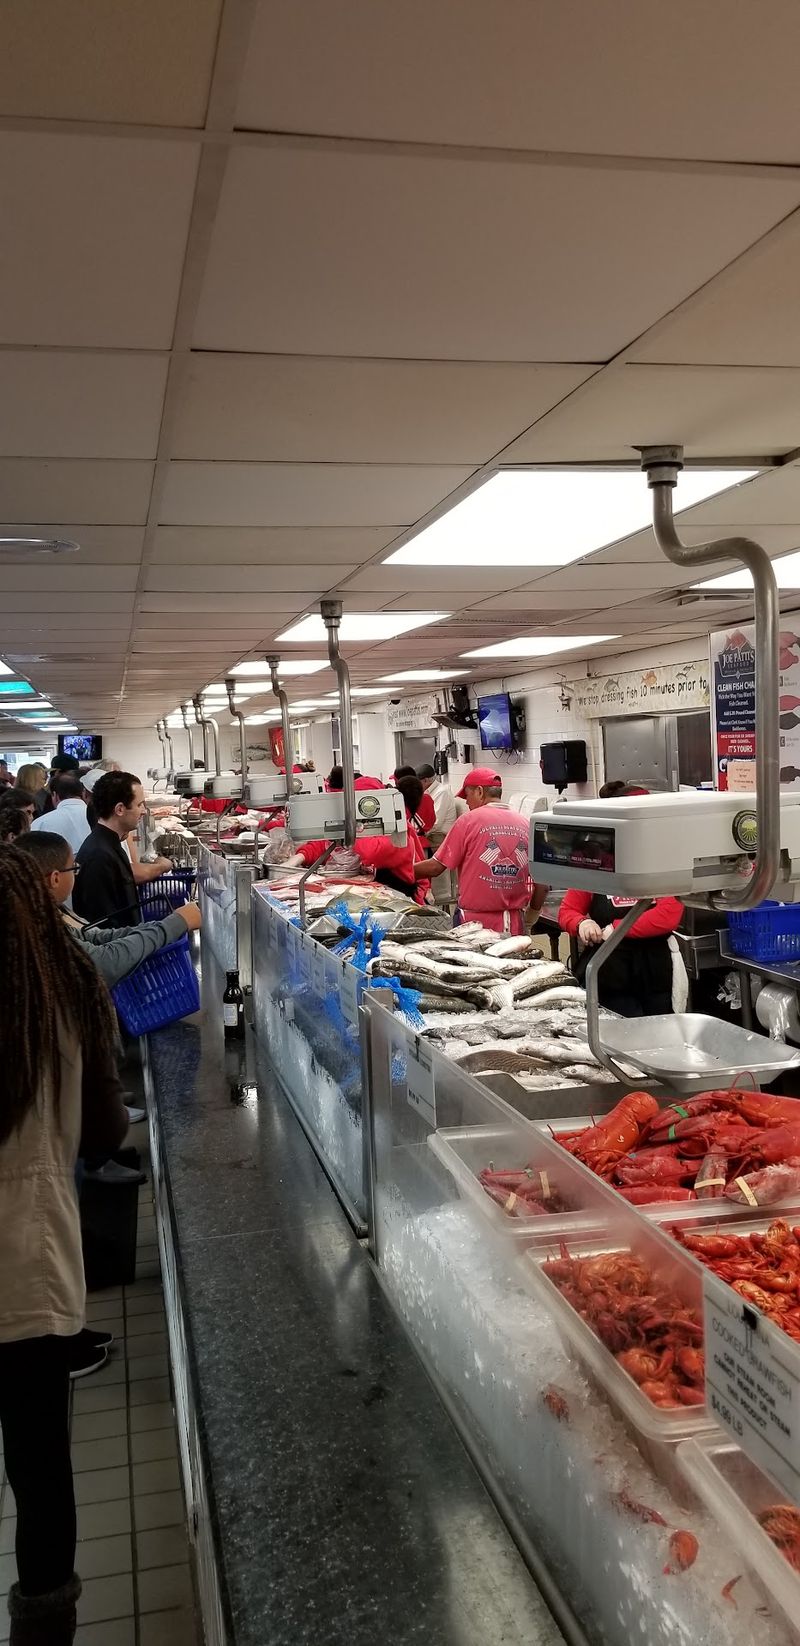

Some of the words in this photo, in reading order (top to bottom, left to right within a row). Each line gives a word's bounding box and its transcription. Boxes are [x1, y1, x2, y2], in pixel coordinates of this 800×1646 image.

[722, 652, 734, 668] JOE
[588, 695, 599, 707] stop
[600, 689, 624, 704] dressing
[626, 687, 638, 698] fish
[640, 684, 648, 697] 10
[649, 682, 675, 696] minutes
[677, 679, 696, 696] prior
[699, 676, 707, 689] to
[717, 683, 733, 692] CLEAN
[733, 681, 744, 691] FISH
[728, 745, 737, 753] IT'S
[737, 745, 753, 753] YOURS
[712, 1317, 746, 1357] COOKED
[713, 1353, 736, 1379] CANNOT
[737, 1377, 758, 1403] REHEAT
[759, 1399, 769, 1414] OR
[770, 1410, 792, 1438] STEAM
[723, 1352, 735, 1368] OUR
[736, 1363, 756, 1387] STEAM
[756, 1383, 776, 1408] ROOM
[711, 1391, 732, 1425] $4.99
[732, 1415, 744, 1437] LB
[726, 1383, 739, 1402] THIS
[740, 1398, 768, 1430] PRODUCT
